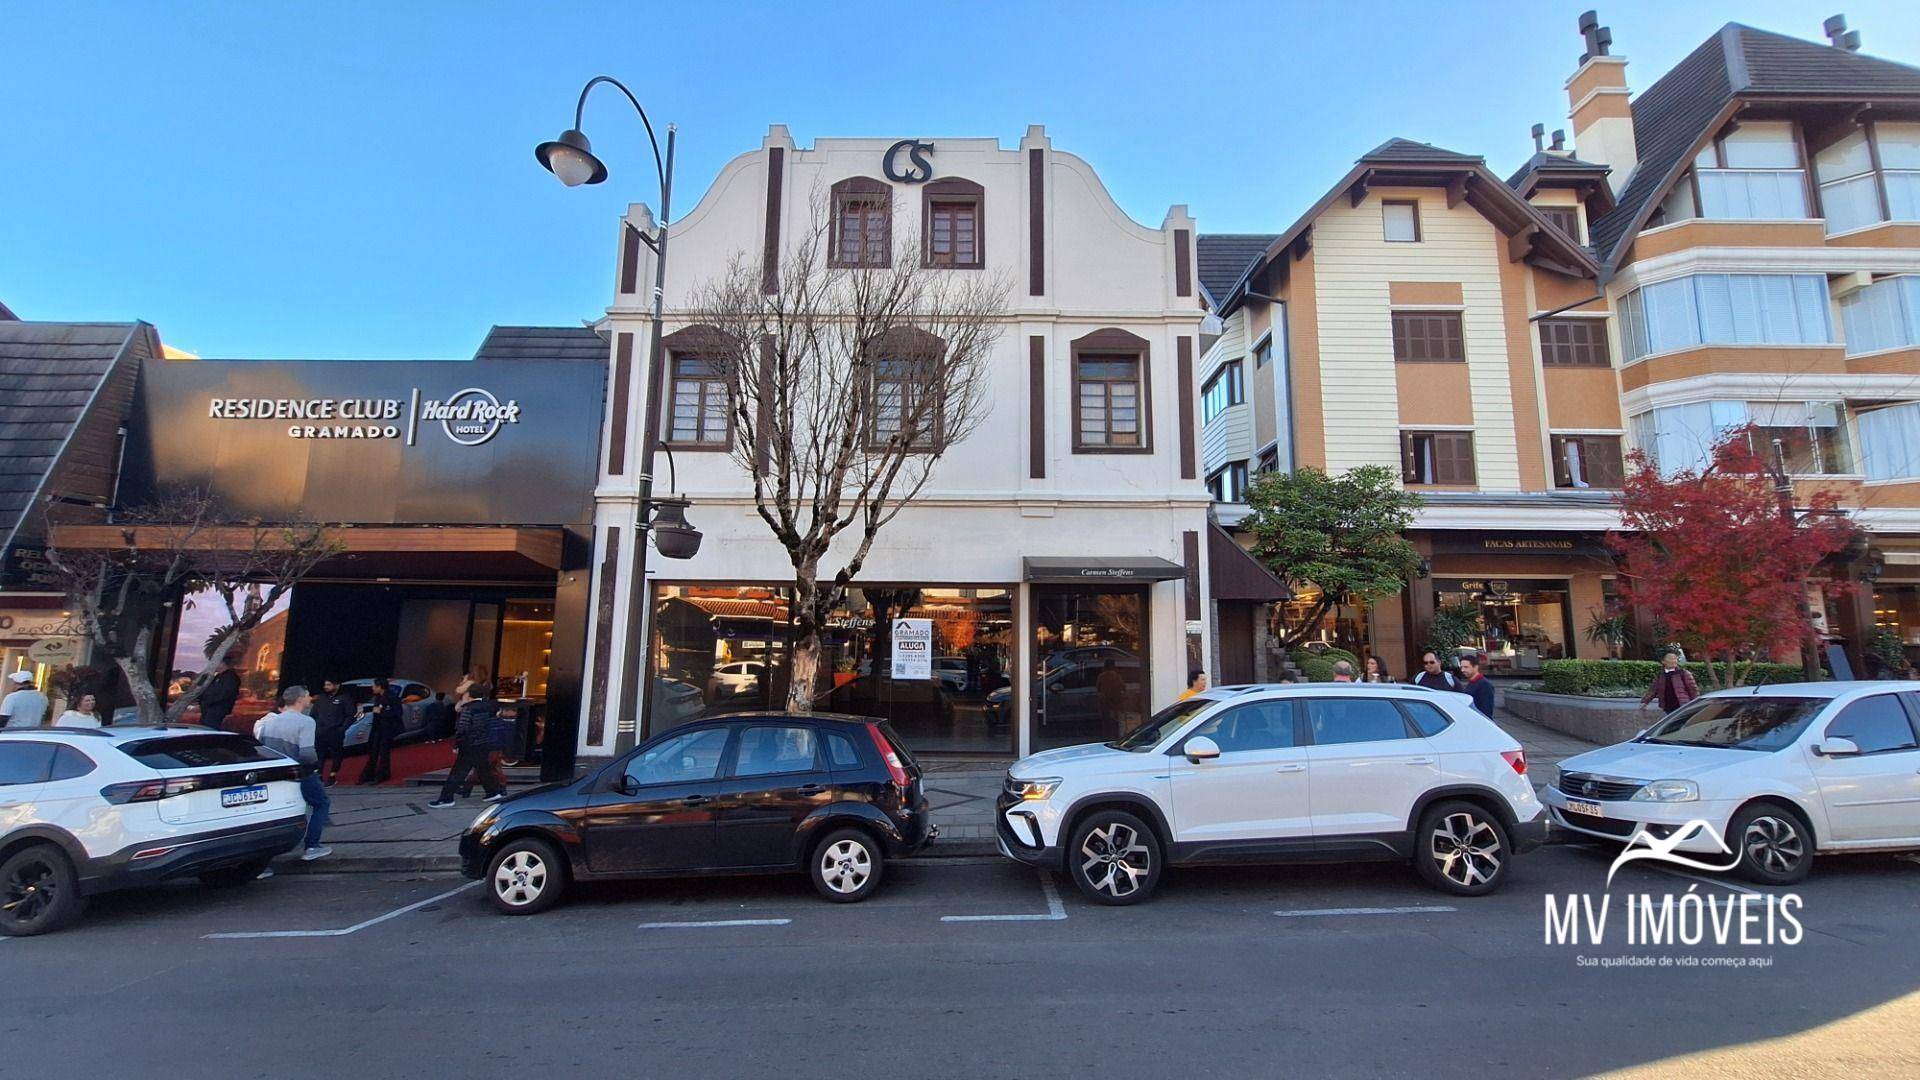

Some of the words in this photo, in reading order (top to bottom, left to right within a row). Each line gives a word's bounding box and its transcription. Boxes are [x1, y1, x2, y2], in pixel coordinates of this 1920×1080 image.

[882, 138, 934, 184] CS
[208, 398, 335, 420] RESIDENCE
[338, 399, 401, 420] CLUB
[421, 399, 474, 420] Hard
[471, 399, 521, 423] Rock
[287, 425, 400, 438] GRAMADO
[455, 425, 486, 435] HOTEL
[1484, 540, 1513, 548] FACAS
[1515, 540, 1573, 549] ARTESANAIS
[1081, 568, 1107, 576] Carmen
[1108, 568, 1134, 577] Steffens
[835, 616, 875, 629] Steffens
[900, 641, 925, 651] ALUGA
